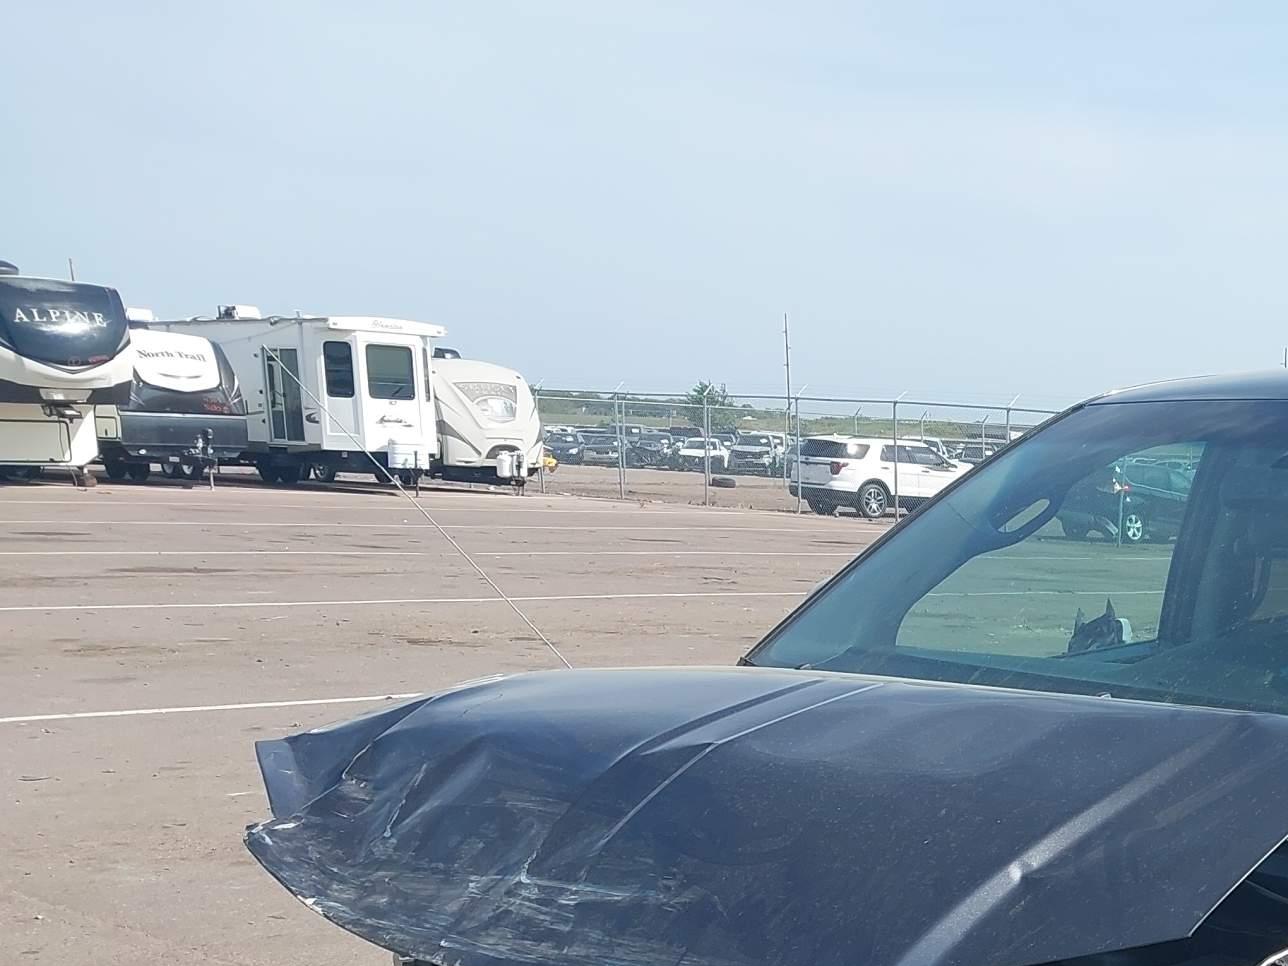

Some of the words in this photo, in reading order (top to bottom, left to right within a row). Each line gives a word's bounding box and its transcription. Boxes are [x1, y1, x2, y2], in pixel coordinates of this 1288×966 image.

[13, 307, 108, 328] ALPINE
[136, 349, 174, 360] North
[175, 351, 206, 362] Trail
